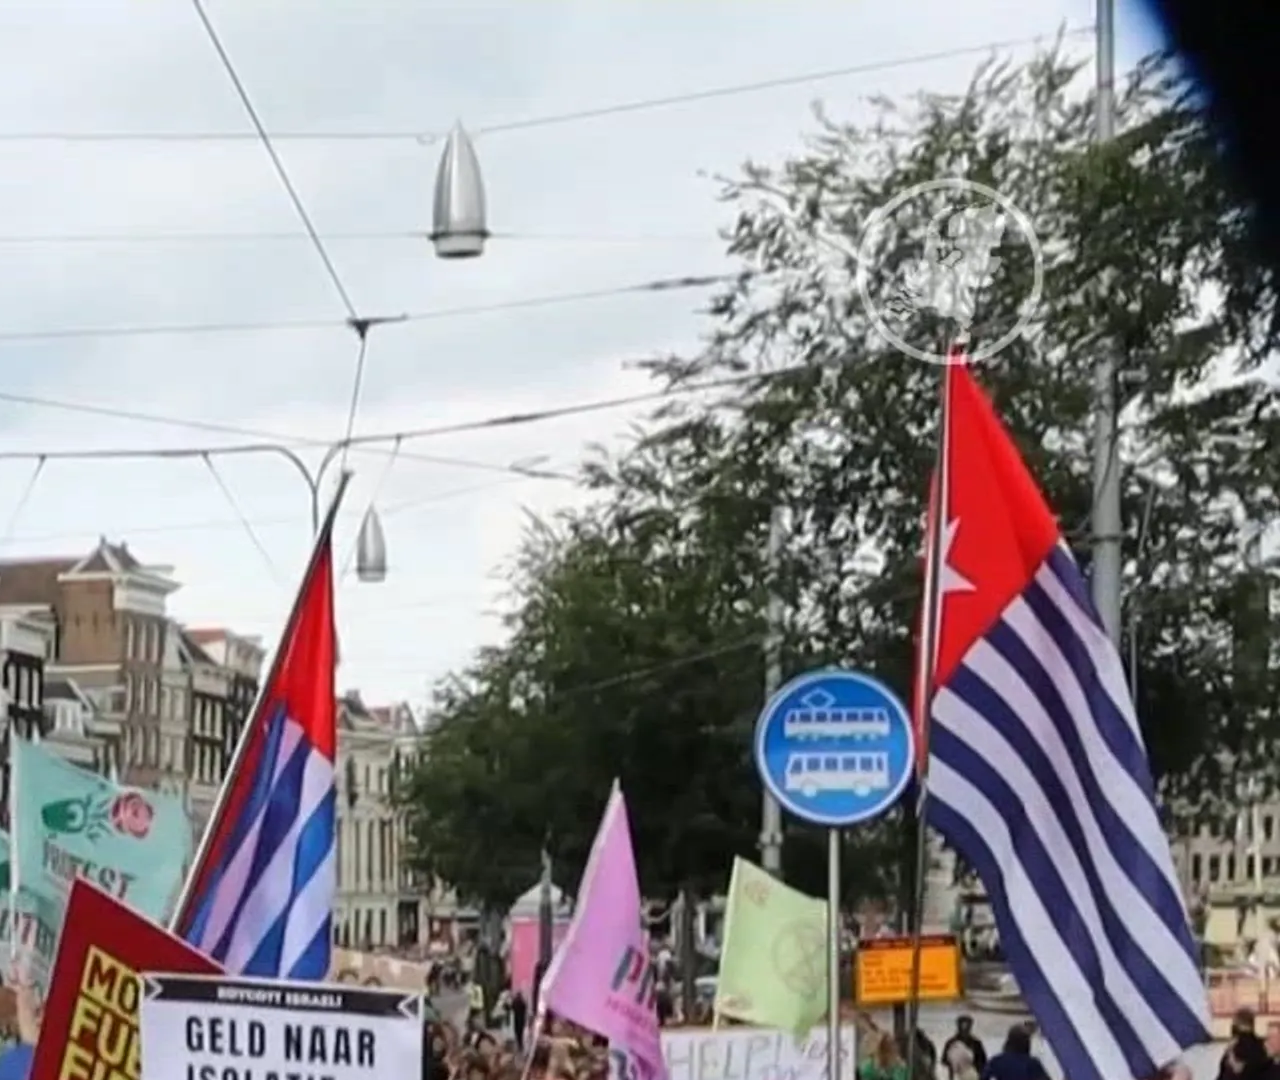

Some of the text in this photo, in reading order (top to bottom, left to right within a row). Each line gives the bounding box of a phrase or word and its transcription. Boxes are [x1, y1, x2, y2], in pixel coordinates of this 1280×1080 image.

[217, 986, 281, 1005] BOYCOTT
[185, 1015, 376, 1069] GELD NAAR
